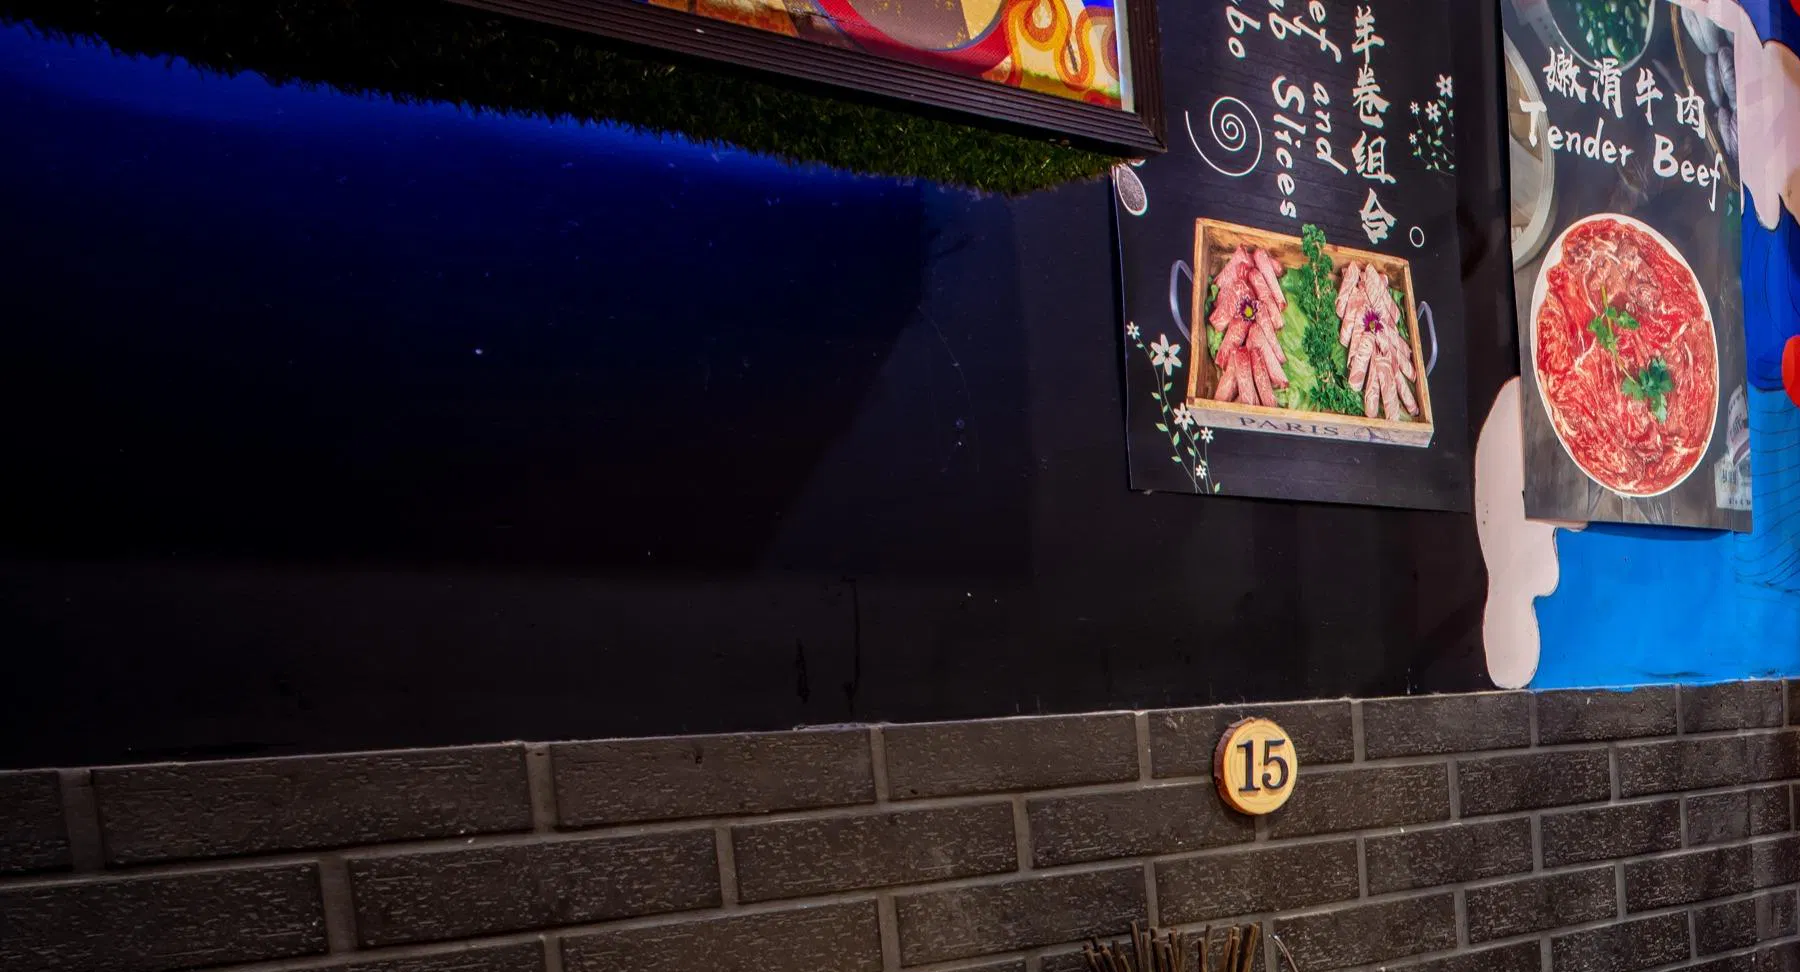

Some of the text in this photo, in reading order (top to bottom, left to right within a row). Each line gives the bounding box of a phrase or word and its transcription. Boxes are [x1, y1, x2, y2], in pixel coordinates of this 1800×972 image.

[1292, 0, 1349, 175] ef and
[1542, 46, 1707, 139] 嫩滑牛肉
[1271, 74, 1307, 219] Slices
[1518, 97, 1724, 213] Tender Beef
[1239, 416, 1340, 436] PARIS
[1236, 738, 1290, 793] 15
